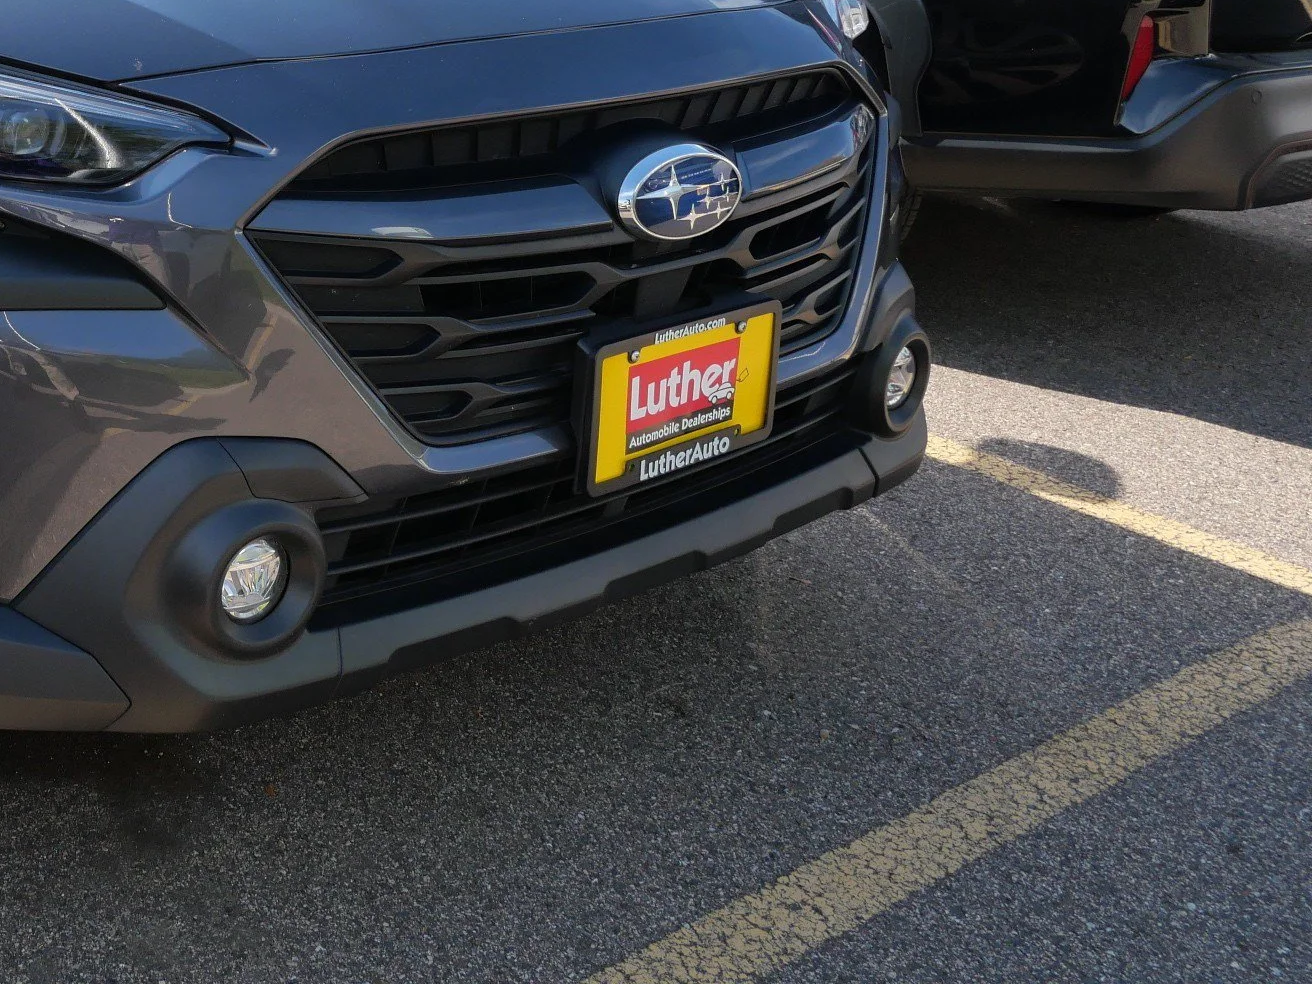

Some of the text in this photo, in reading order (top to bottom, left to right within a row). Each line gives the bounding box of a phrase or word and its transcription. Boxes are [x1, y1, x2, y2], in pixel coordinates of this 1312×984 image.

[654, 317, 726, 345] LutherAuto.com
[630, 358, 736, 421] Luther
[629, 406, 731, 449] Automobile Dealerships
[639, 436, 730, 481] LutherAuto
